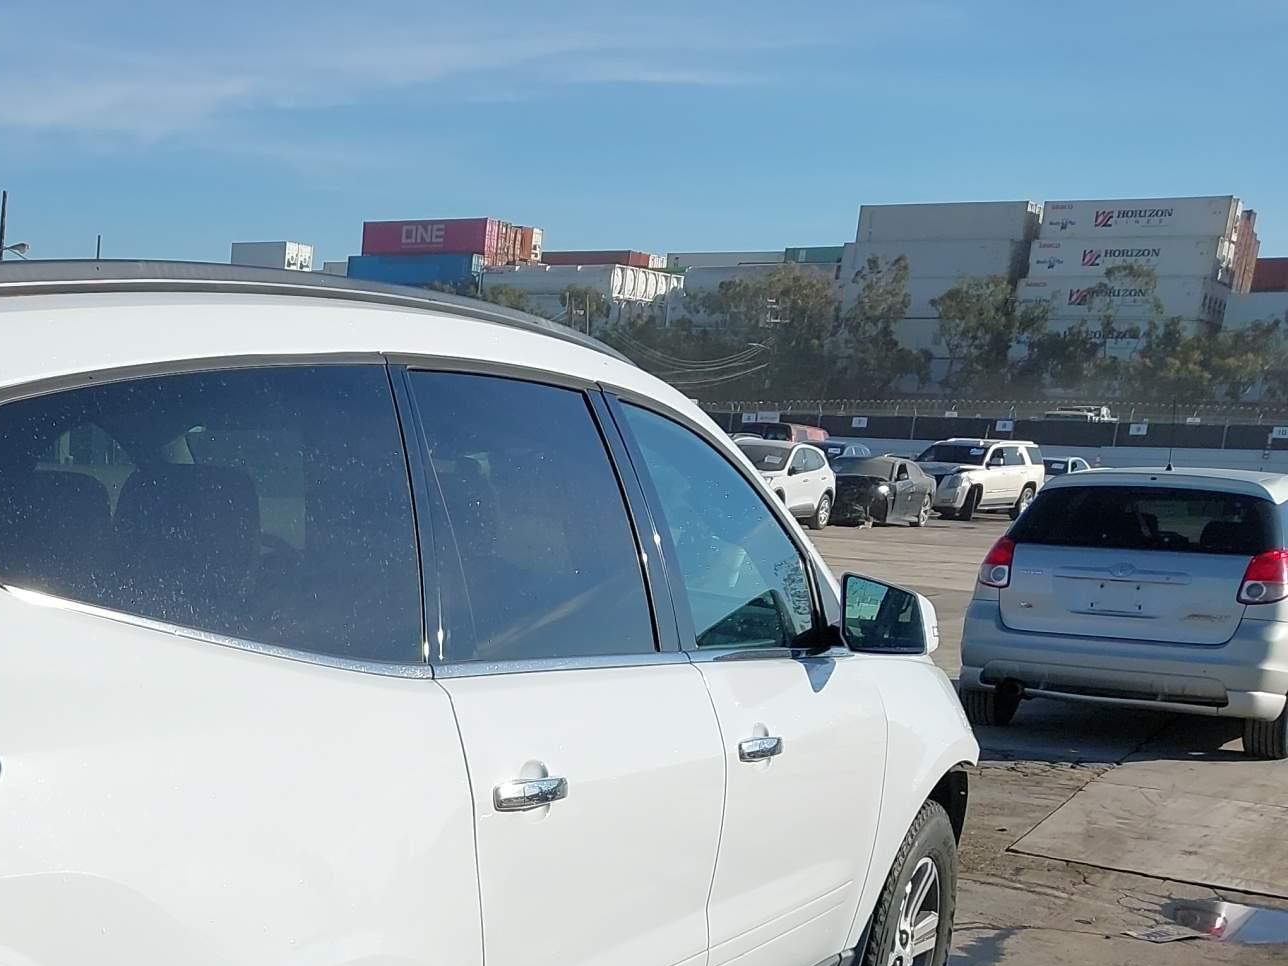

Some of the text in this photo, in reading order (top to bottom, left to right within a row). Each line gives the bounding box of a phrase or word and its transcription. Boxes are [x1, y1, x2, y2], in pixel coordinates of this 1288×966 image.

[1116, 208, 1174, 218] HORIZON
[400, 223, 445, 244] ONE
[1103, 247, 1161, 257] HORIZON
